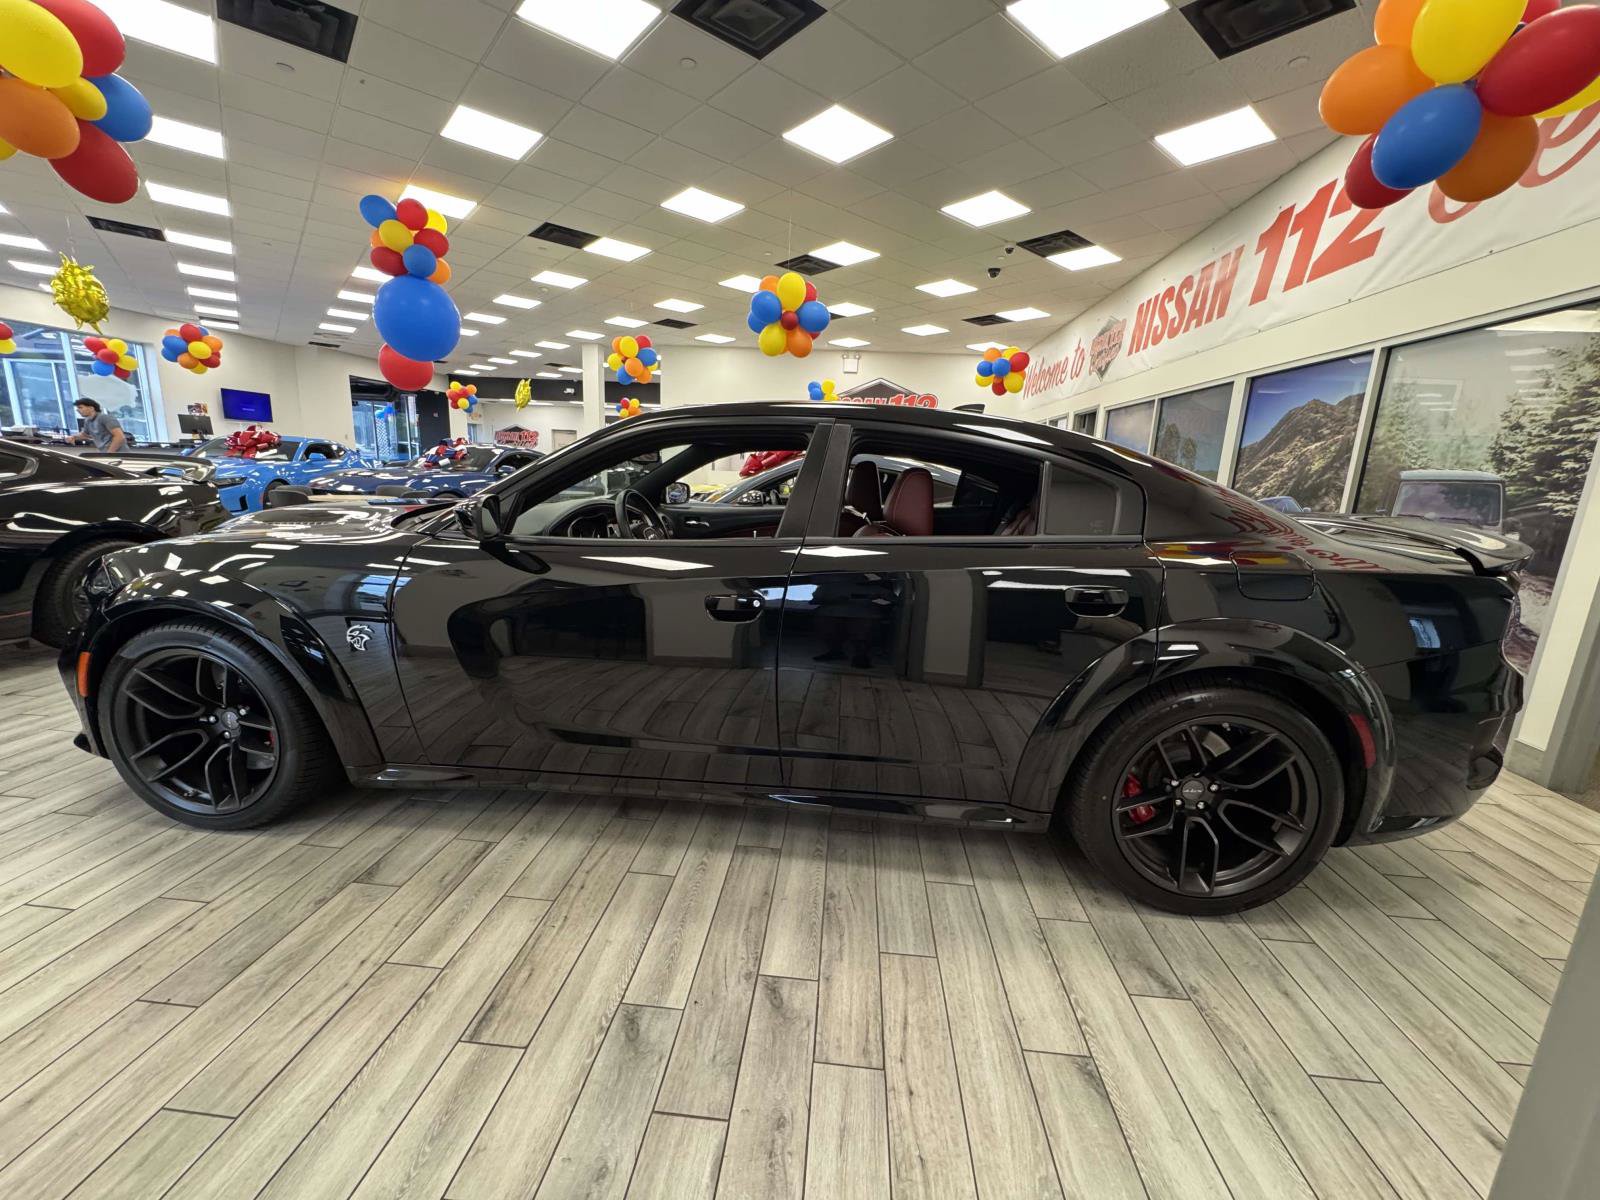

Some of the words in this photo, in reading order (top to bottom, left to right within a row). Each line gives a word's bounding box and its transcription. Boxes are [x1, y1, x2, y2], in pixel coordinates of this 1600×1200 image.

[1023, 356, 1069, 400] Welcome
[1071, 337, 1085, 380] to
[1127, 244, 1245, 357] NISSAN
[1248, 178, 1385, 307] 112
